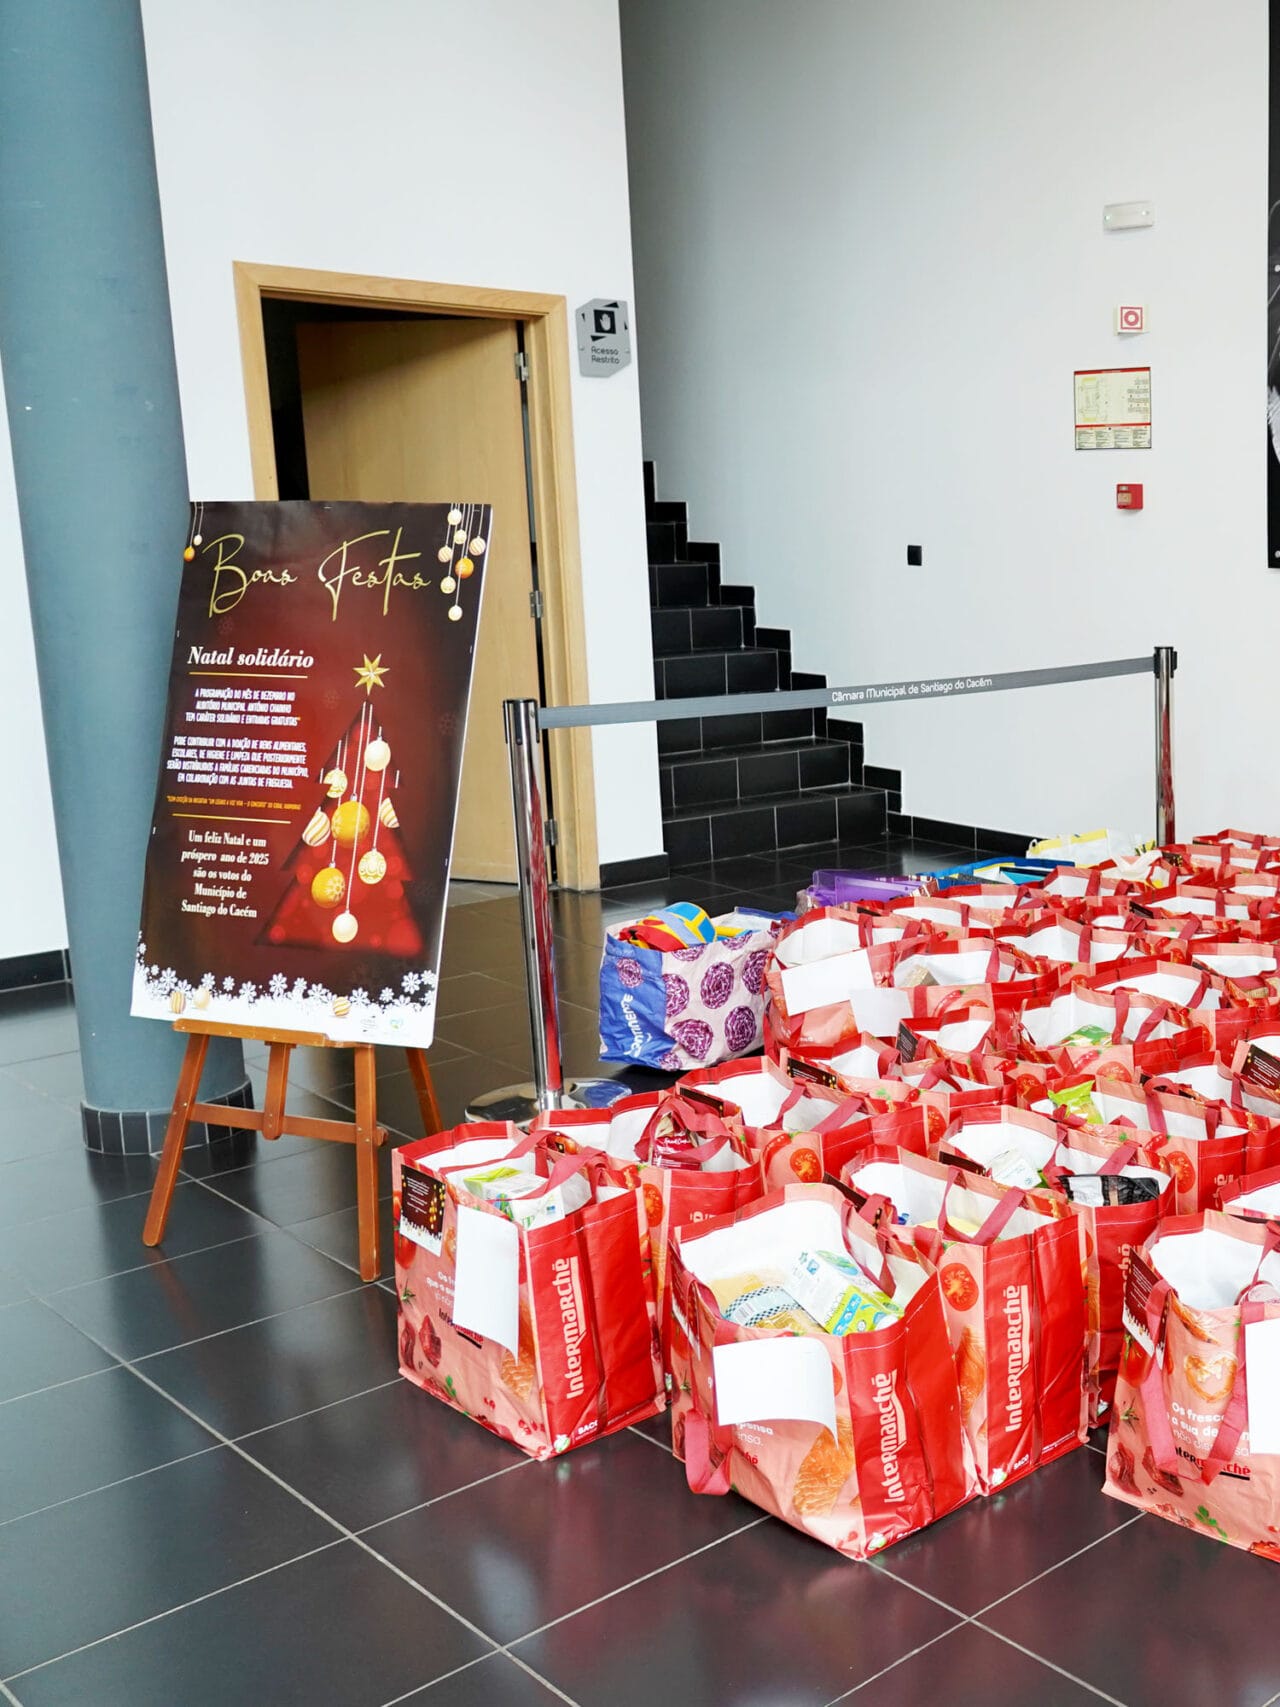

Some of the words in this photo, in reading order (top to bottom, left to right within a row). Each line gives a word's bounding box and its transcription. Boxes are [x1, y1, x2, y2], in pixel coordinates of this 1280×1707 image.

[202, 533, 298, 618] Boas
[318, 526, 431, 622] Festas
[187, 646, 235, 666] Natal
[236, 648, 314, 669] solidário
[831, 690, 864, 702] Câmara
[866, 688, 907, 700] Municipal
[908, 685, 919, 696] de
[920, 682, 953, 694] Santiago
[954, 679, 965, 689] do
[966, 677, 993, 688] Cacém
[188, 829, 203, 843] Um
[204, 831, 222, 844] feliz
[223, 832, 245, 846] Natal
[252, 838, 267, 847] um
[181, 848, 217, 864] próspero
[220, 853, 235, 863] ano
[236, 851, 248, 864] de
[248, 852, 269, 865] 2025
[193, 866, 207, 878] são
[207, 871, 217, 879] os
[218, 870, 240, 881] votos
[240, 869, 252, 882] do
[194, 883, 235, 901] Município
[235, 886, 247, 899] de
[181, 899, 216, 918] Santiago
[217, 902, 228, 915] do
[229, 903, 257, 918] Cacém
[1172, 1402, 1186, 1415] Os
[1187, 1409, 1224, 1422] fresc
